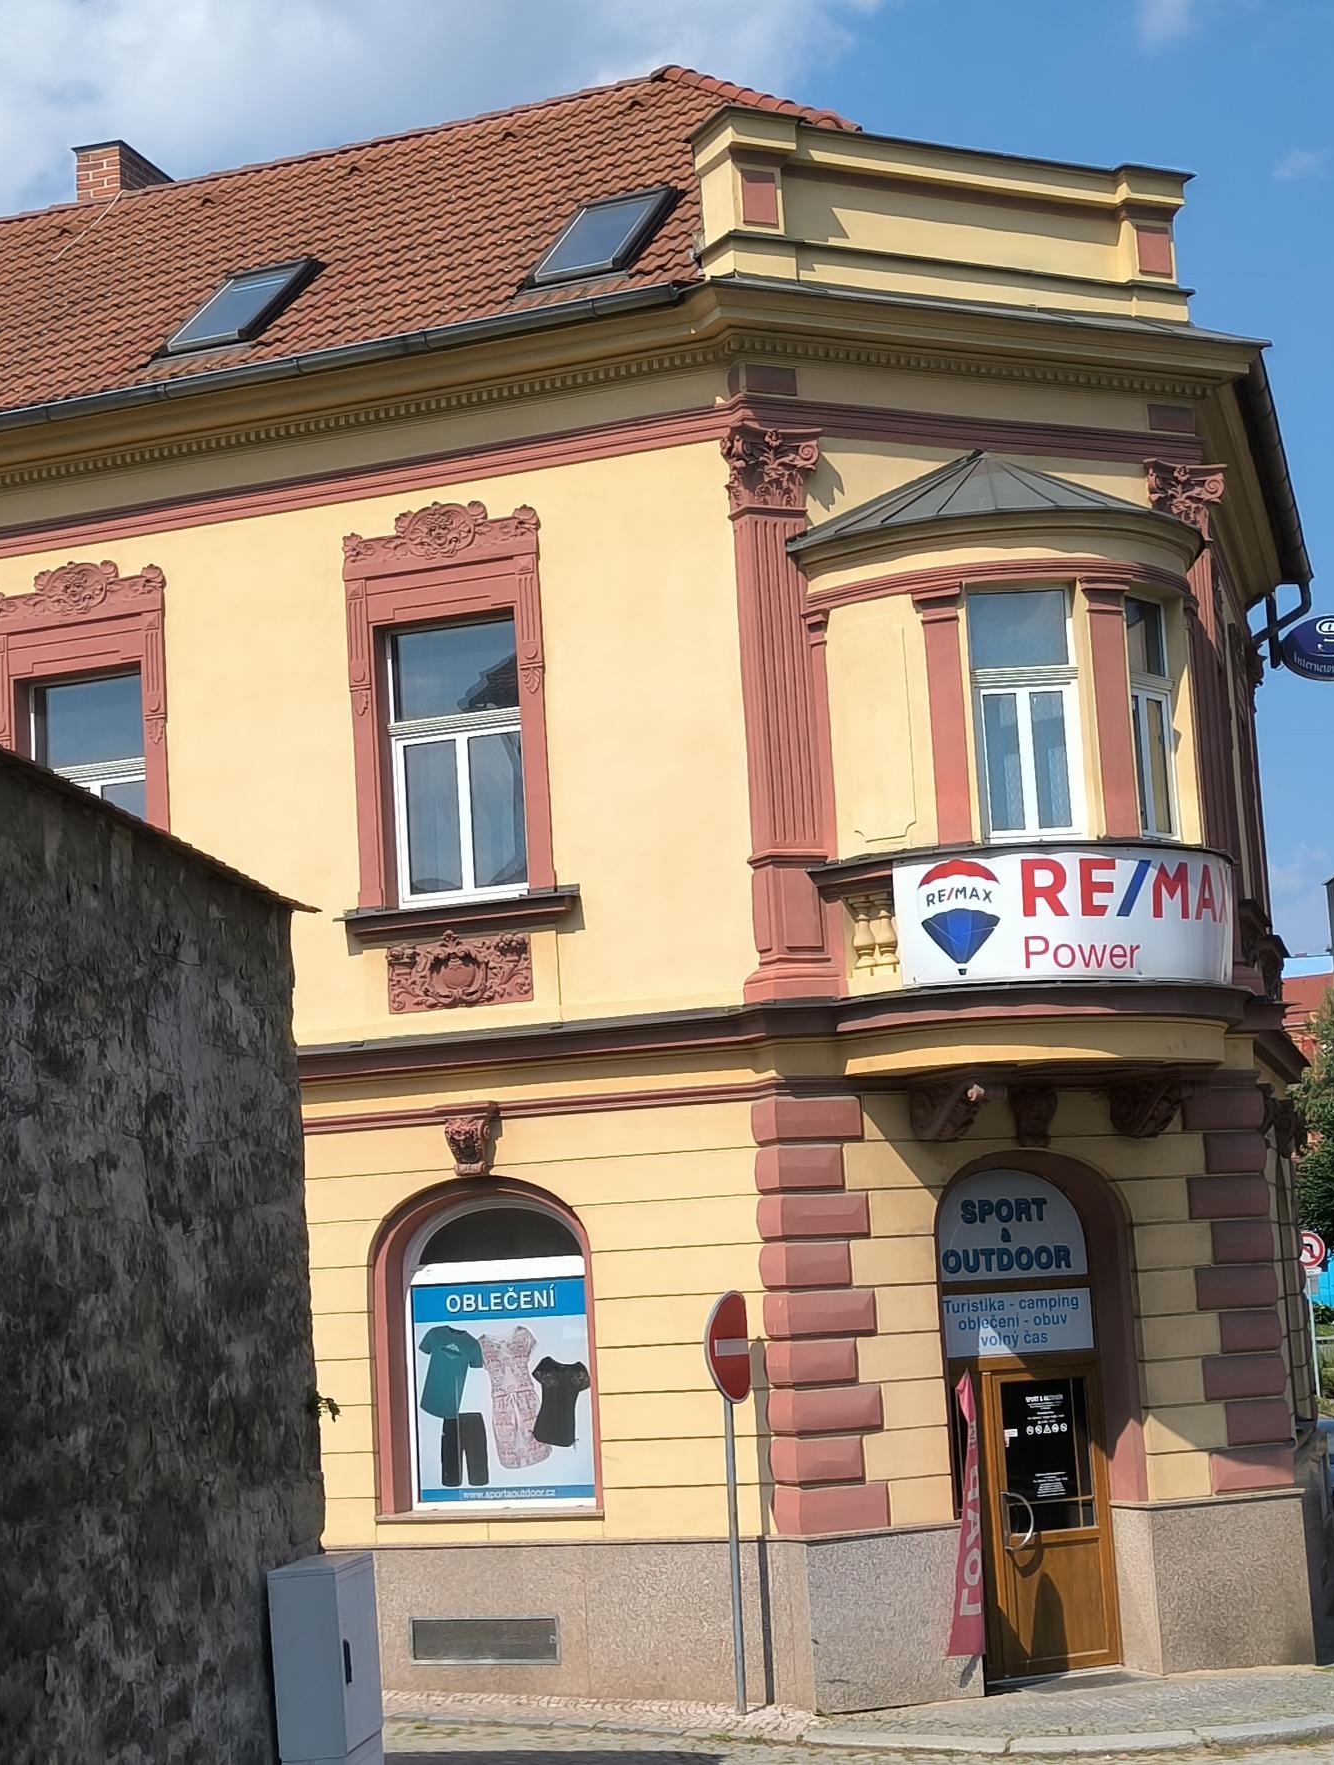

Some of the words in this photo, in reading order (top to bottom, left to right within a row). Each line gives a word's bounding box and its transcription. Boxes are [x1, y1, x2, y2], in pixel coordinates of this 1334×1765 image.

[926, 886, 993, 908] RE/MAX
[1024, 935, 1141, 970] Power
[960, 1197, 1047, 1224] SPORT
[1000, 1227, 1012, 1243] &
[942, 1245, 1072, 1274] OUTDOOR
[445, 1284, 556, 1314] OBLEČENÍ
[943, 1298, 1005, 1314] Turistika
[1019, 1293, 1079, 1312] camping
[958, 1313, 1019, 1331] oblečení
[1033, 1312, 1068, 1326] obuv
[981, 1332, 1019, 1348] volný
[1024, 1330, 1048, 1344] čas
